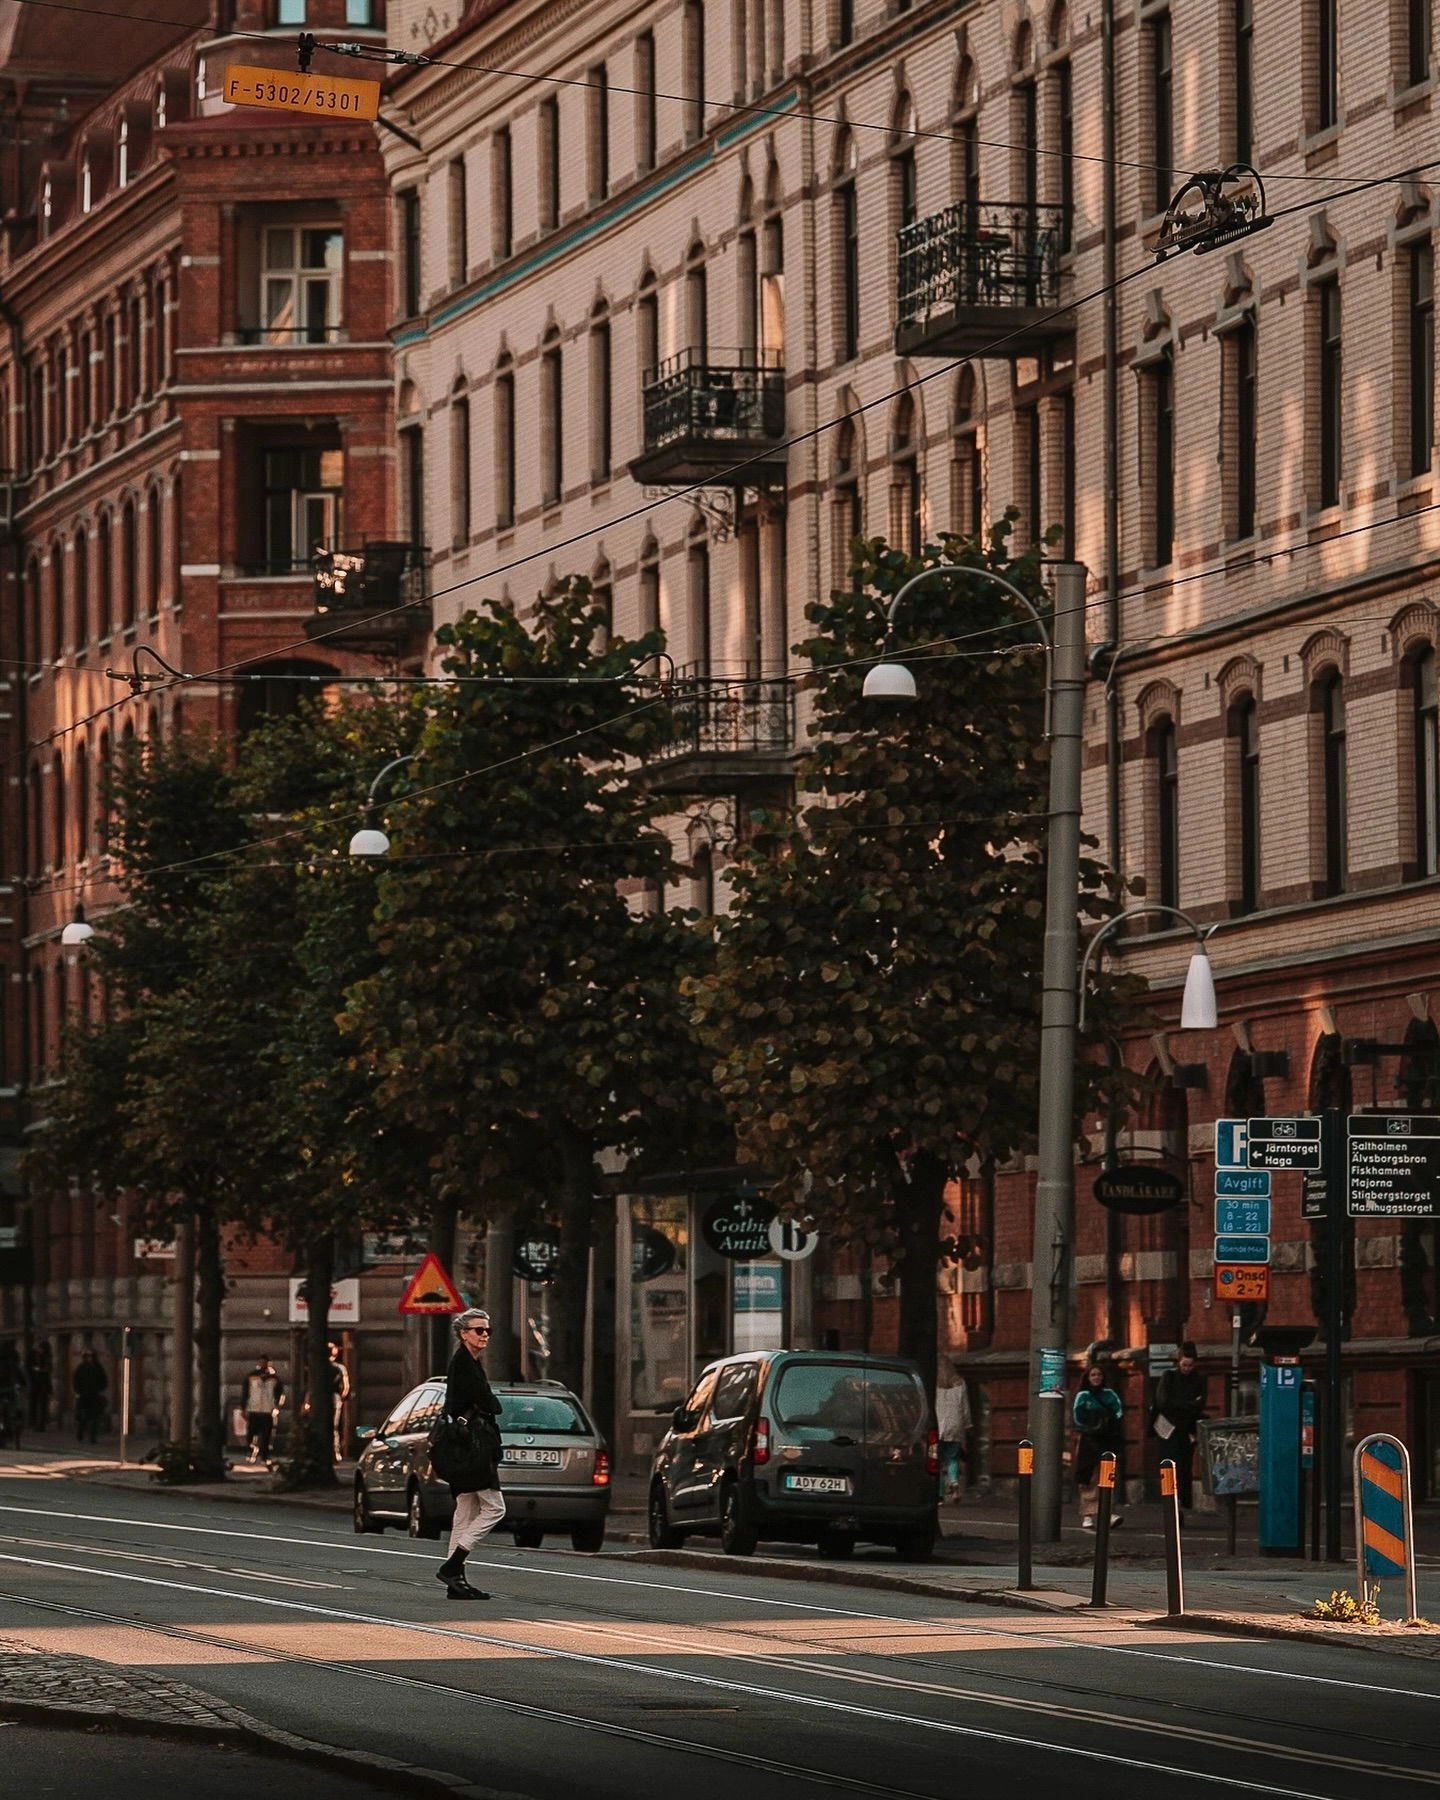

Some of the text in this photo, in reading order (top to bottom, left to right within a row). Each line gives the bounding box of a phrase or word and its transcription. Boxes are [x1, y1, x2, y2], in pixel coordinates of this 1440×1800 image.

[229, 80, 360, 112] F-5302/5301
[1265, 1143, 1318, 1155] Järntorget
[1351, 1141, 1408, 1151] Saltholmen
[1265, 1156, 1292, 1167] Haga
[1351, 1151, 1427, 1165] Älvsborgsbron
[1351, 1166, 1411, 1176] Fiskhamnen
[1224, 1177, 1263, 1191] Avgift
[1351, 1178, 1393, 1189] Majorna
[1351, 1190, 1431, 1202] Stigbergstorget
[1225, 1201, 1260, 1209] 30 min
[718, 1235, 768, 1251] Antik
[1235, 1270, 1266, 1281] Onsd
[535, 1451, 557, 1462] 820
[795, 1477, 817, 1488] ADY
[819, 1478, 841, 1490] 62H
